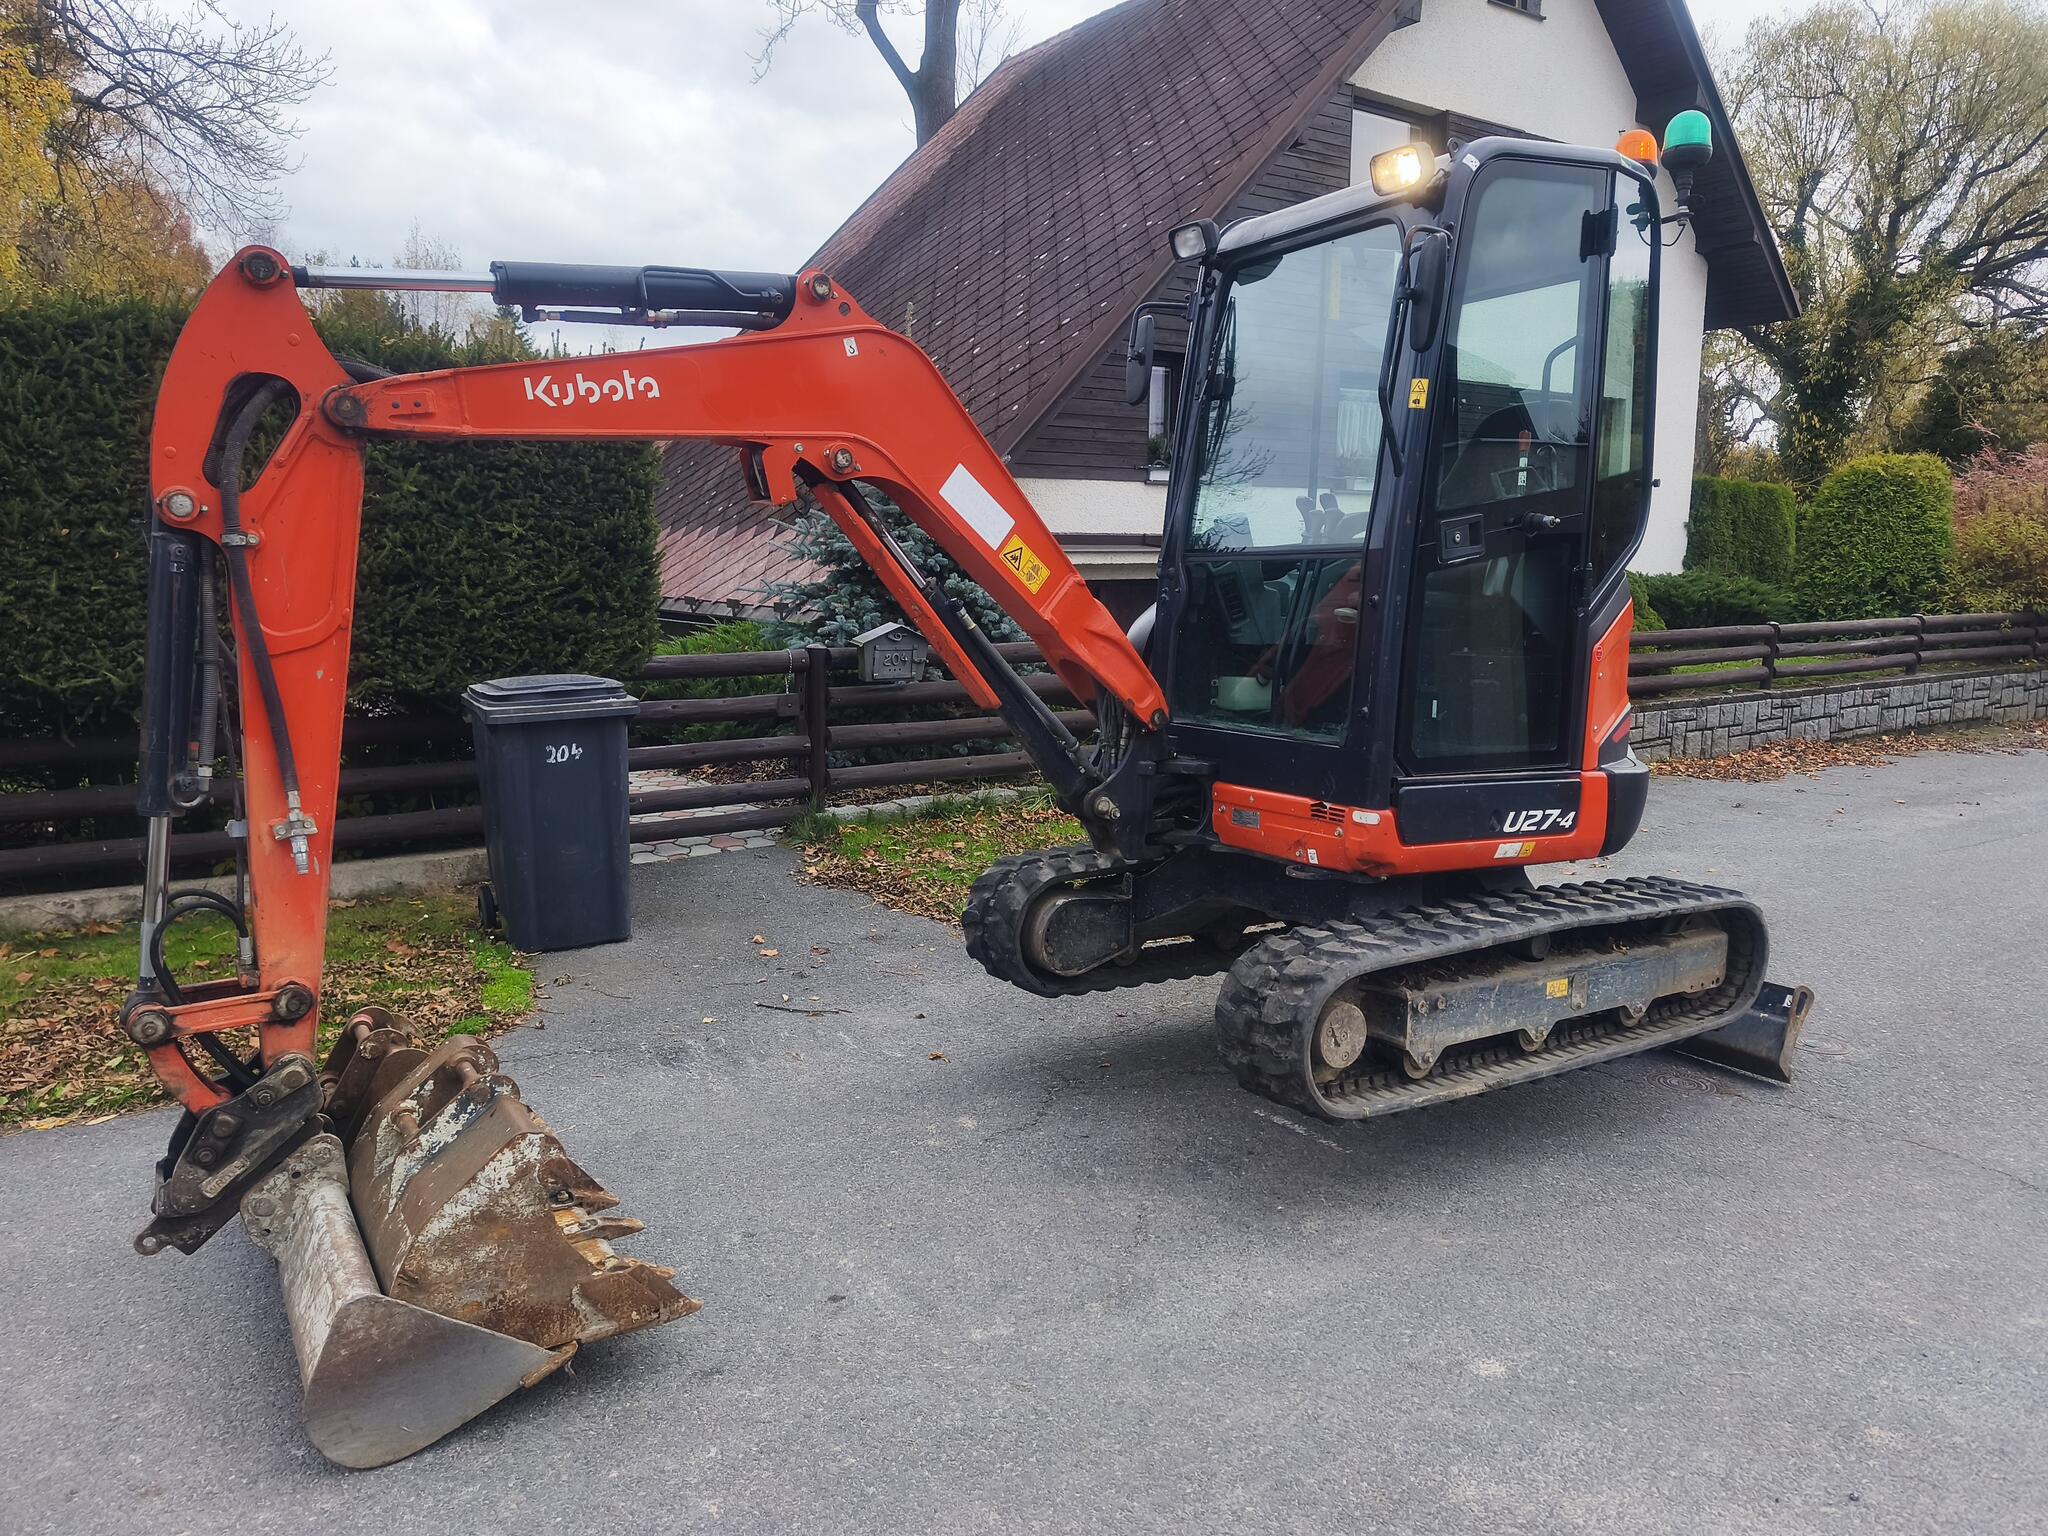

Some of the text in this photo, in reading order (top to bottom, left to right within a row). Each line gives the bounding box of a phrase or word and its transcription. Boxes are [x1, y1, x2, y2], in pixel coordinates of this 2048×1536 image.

[524, 370, 660, 407] Kubota
[884, 652, 908, 667] 204
[545, 743, 583, 764] 204
[1503, 808, 1577, 833] U27-4
